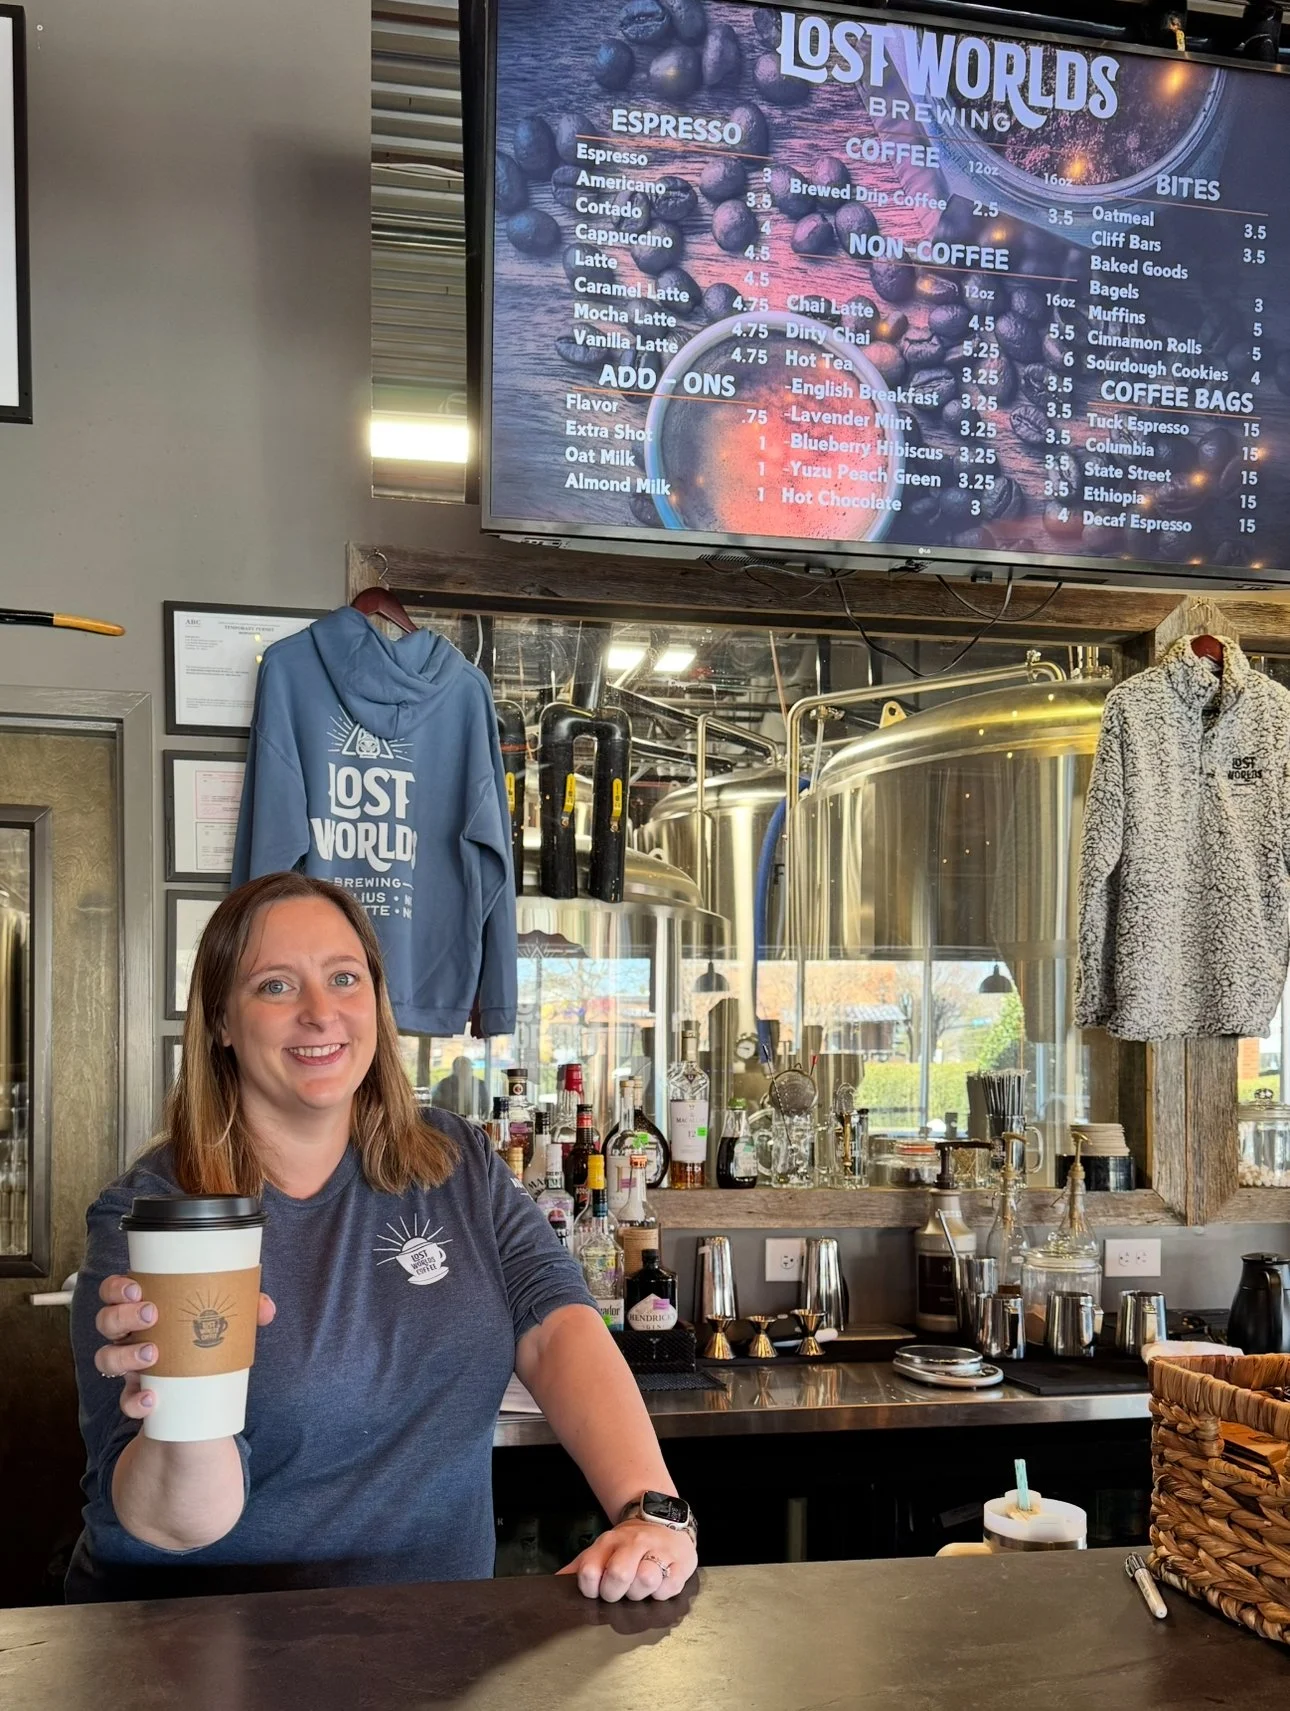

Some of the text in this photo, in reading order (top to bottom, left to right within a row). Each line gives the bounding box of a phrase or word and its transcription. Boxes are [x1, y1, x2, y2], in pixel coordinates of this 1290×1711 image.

[776, 11, 1120, 130] LOST WORLDS
[612, 108, 742, 146] ESPRESSO
[870, 98, 1010, 132] BREWING
[576, 143, 772, 183] Espresso 3
[846, 137, 940, 169] COFFEE
[576, 170, 772, 210] Americano 3.5
[968, 160, 1073, 188] 12oz 16oz
[1156, 174, 1220, 201] BITES
[576, 198, 771, 236] Cortado 4
[790, 180, 1073, 226] Brewed Drip Coffee 2.5 3.5
[1092, 205, 1267, 240] Oatmeal 3.5
[575, 224, 770, 261] Cappuccino 4.5
[849, 232, 1009, 271] NON-COFFEE
[1091, 230, 1266, 265] Cliff Bars 3.5
[575, 250, 770, 287] Latte 4.5
[1090, 255, 1188, 280] Baked Goods
[574, 276, 768, 312] Caramel Latte 4.75
[964, 285, 1075, 309] 12oz 16oz
[1090, 280, 1263, 314] Bagels 3
[574, 304, 768, 339] Mocha Latte 4.75
[787, 295, 1075, 340] Chai Latte 4.5 5.5
[1089, 304, 1262, 337] Muffins 5
[574, 330, 768, 364] Vanilla Latte 4.75
[786, 323, 1073, 366] Dirty Chai 5.25 6
[1088, 330, 1261, 361] Cinnamon Rolls 5
[599, 364, 656, 389] ADD
[684, 372, 736, 397] ONS
[785, 349, 1073, 393] Hot Tea 3.25 3.5
[1086, 354, 1260, 386] Sourdough Cookies 4
[566, 394, 767, 424] Flavor .75
[859, 384, 939, 406] Breakfast
[961, 394, 998, 411] 3.25
[1046, 402, 1072, 420] 3.5
[1101, 381, 1254, 414] COFFEE BAGS
[566, 420, 765, 449] Extra Shot 1
[874, 412, 912, 431] Mint
[960, 421, 997, 437] 3.25
[1045, 428, 1071, 446] 3.5
[1087, 412, 1260, 437] Tuck Espresso 15
[566, 447, 765, 476] Oat Milk 1
[877, 440, 943, 460] Hibiscus
[959, 447, 996, 463] 3.25
[1044, 454, 1071, 471] 3.5
[1086, 438, 1258, 461] Columbia 15
[565, 473, 764, 502] Almond Milk 1
[837, 464, 888, 484] Peach
[894, 468, 941, 488] Green
[958, 473, 994, 490] 3.25
[1044, 480, 1069, 497] 3.5
[1085, 461, 1257, 486] State Street 15
[782, 487, 1068, 523] Hot Chocolate 3 4
[1084, 486, 1256, 510] Ethiopia 15
[1083, 510, 1256, 535] Decaf Espresso 15
[328, 762, 416, 820] LOST
[334, 876, 401, 888] BREWING
[411, 1250, 428, 1262] LOST
[411, 1256, 436, 1270] WORLDS
[416, 1264, 437, 1275] COFFEE
